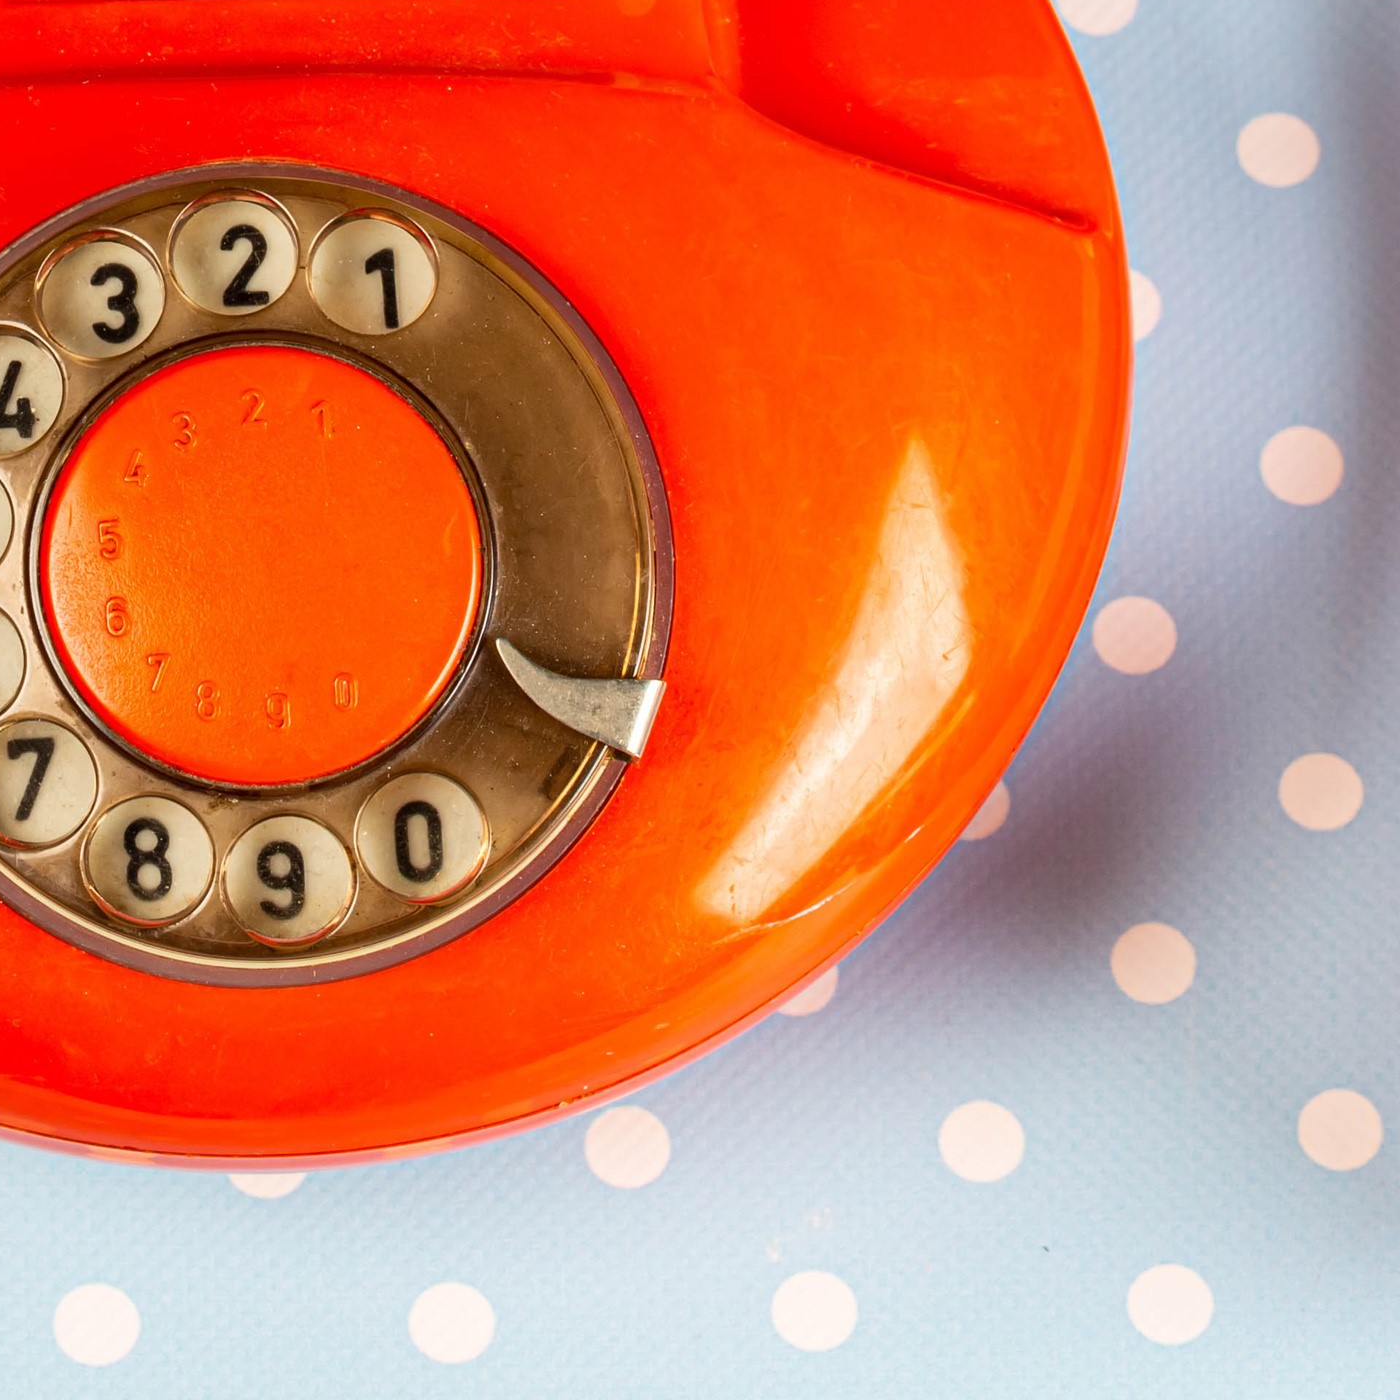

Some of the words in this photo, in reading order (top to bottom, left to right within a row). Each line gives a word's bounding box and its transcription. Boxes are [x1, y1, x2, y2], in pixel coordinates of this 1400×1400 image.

[220, 225, 269, 307] 2
[91, 263, 140, 344] 3
[365, 249, 399, 329] 1
[241, 388, 268, 430] 2
[312, 400, 335, 440] 1
[172, 411, 198, 454] 3
[123, 449, 150, 487] 4
[98, 518, 123, 560] 5
[105, 596, 131, 637] 6
[147, 652, 171, 692] 7
[333, 672, 359, 711] 0
[195, 680, 221, 721] 8
[265, 692, 291, 729] 9
[7, 738, 54, 821] 7
[124, 818, 172, 901] 8
[394, 801, 442, 883] 0
[257, 841, 305, 920] 9
